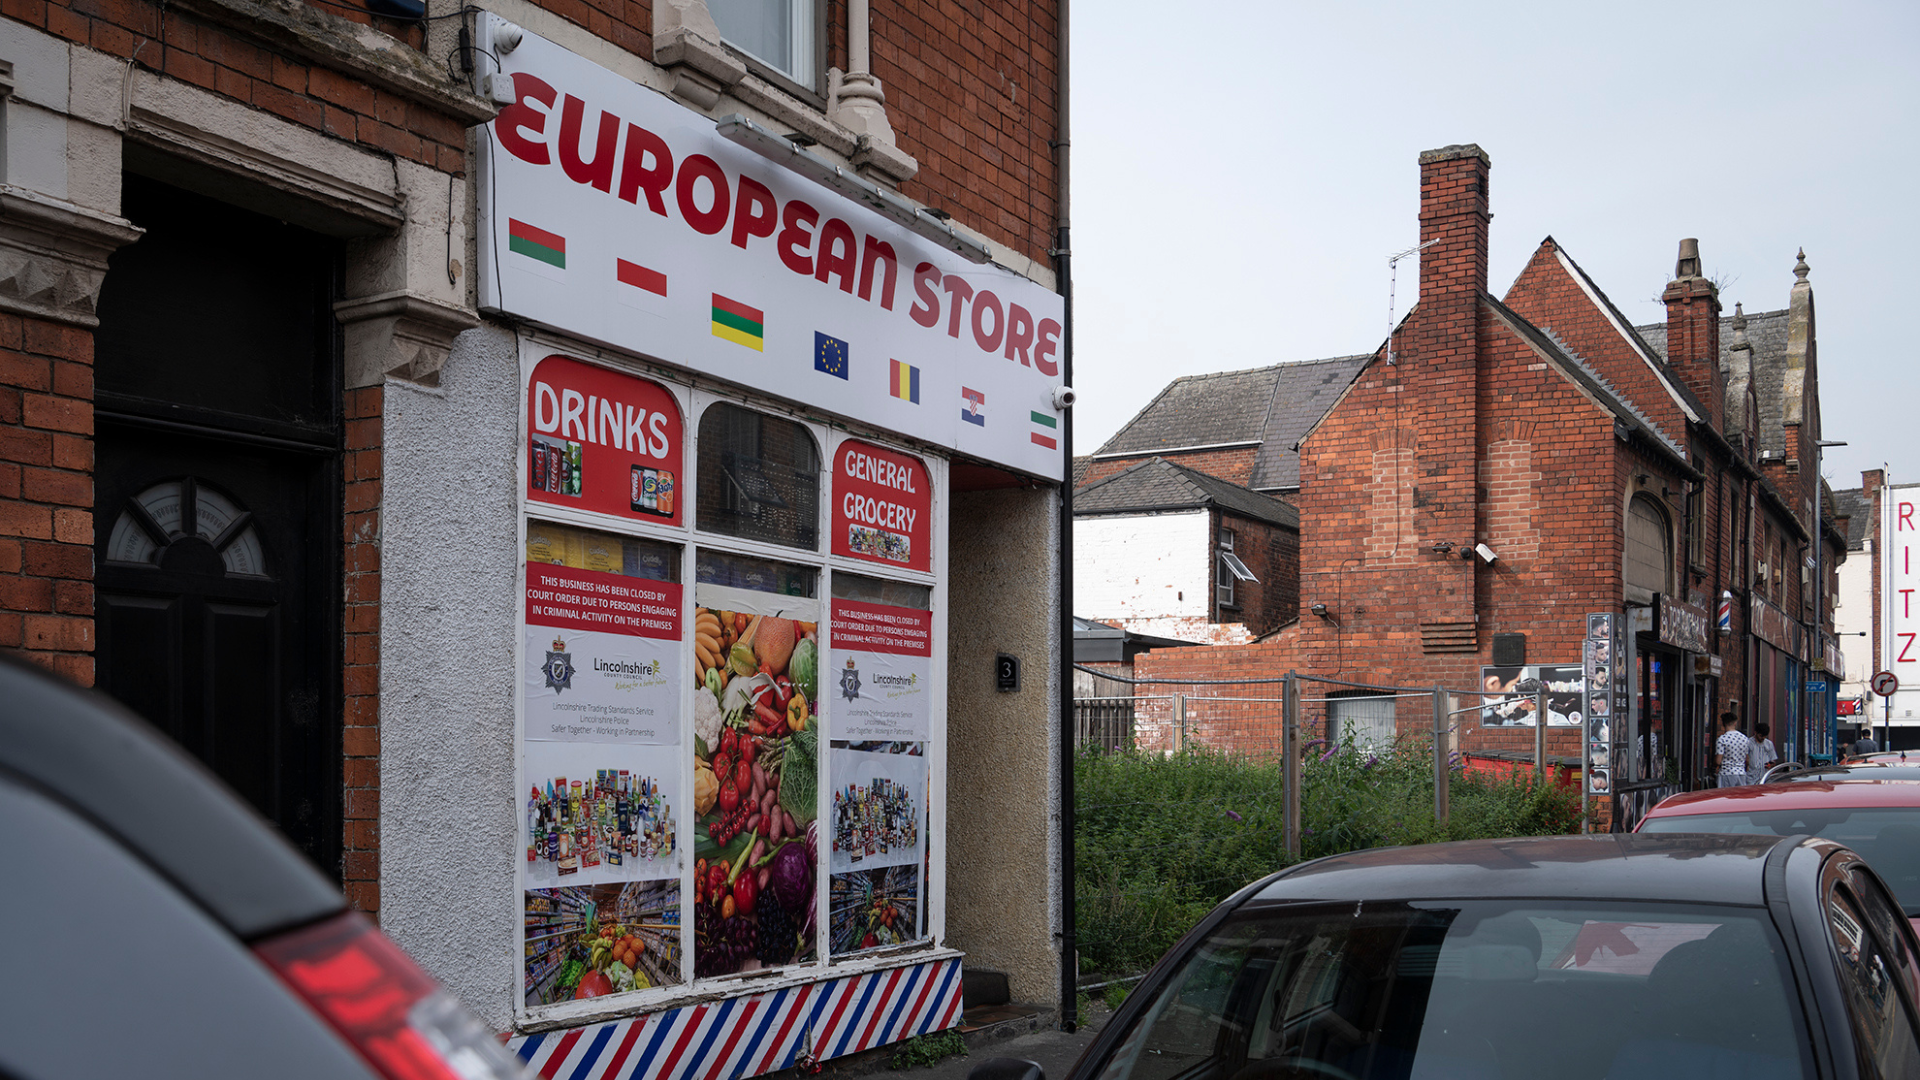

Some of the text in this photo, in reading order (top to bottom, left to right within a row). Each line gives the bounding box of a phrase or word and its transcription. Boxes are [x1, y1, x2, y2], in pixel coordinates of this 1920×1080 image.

[495, 72, 1062, 377] EUROPEAN STORE
[534, 381, 669, 459] DRINKS
[845, 450, 915, 493] GENERAL
[844, 492, 916, 532] GROCERY
[540, 576, 666, 602] THIS BUSINESS HAS BEEN CLOSED BY
[1897, 502, 1916, 662] RITZ
[527, 589, 676, 617] COURT ORDER DUE TO PERSONS ENGAGING
[532, 605, 672, 630] IN CRIMINAL ACTIVITY ON THE PREMISES
[594, 658, 652, 675] Lincolnshire
[1002, 662, 1011, 678] 3
[552, 702, 654, 716] Lincolnshire Trading Standards Service
[580, 715, 629, 725] Lincolnshire Police
[552, 724, 566, 733] Safer
[568, 725, 592, 736] Together
[596, 727, 618, 737] Working
[625, 728, 655, 737] Partnership
